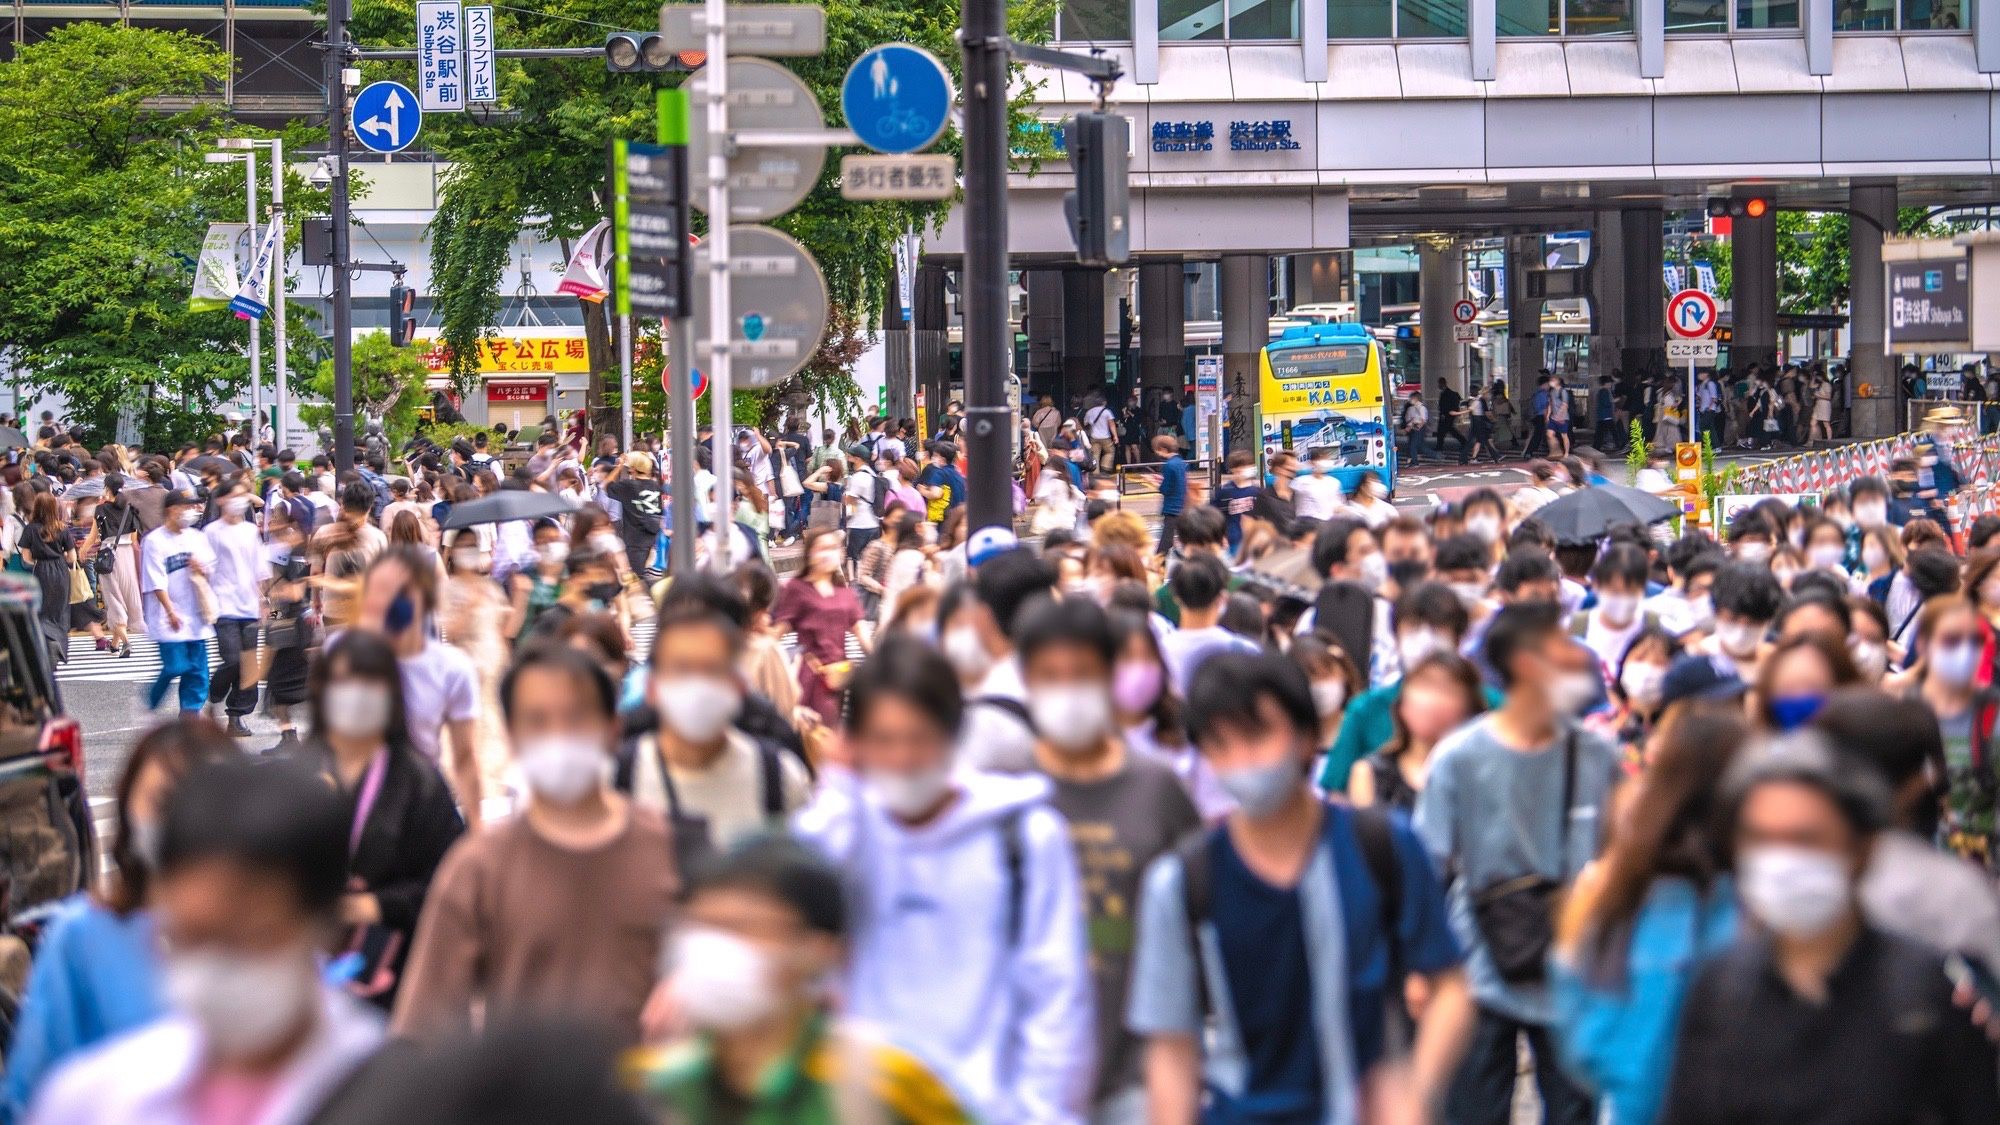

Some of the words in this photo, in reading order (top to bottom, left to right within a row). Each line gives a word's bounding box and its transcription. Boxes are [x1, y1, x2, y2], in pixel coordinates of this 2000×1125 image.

[423, 25, 434, 67] Shibuya
[472, 11, 489, 98] スクランブル式
[437, 10, 457, 102] 渋谷駅前
[425, 71, 436, 92] Sta.
[1230, 120, 1292, 138] 渋谷駅
[1152, 141, 1185, 152] Ginza
[1189, 141, 1212, 151] Line
[1230, 139, 1277, 152] Shibuya
[1279, 139, 1301, 150] Sta.
[849, 165, 944, 188] 歩行者優先
[1904, 299, 1930, 324] 渋谷駅
[1671, 345, 1713, 356] ここまで
[1937, 354, 1950, 366] 40
[498, 362, 554, 371] 宝くじ売場
[1309, 388, 1361, 404] KABA
